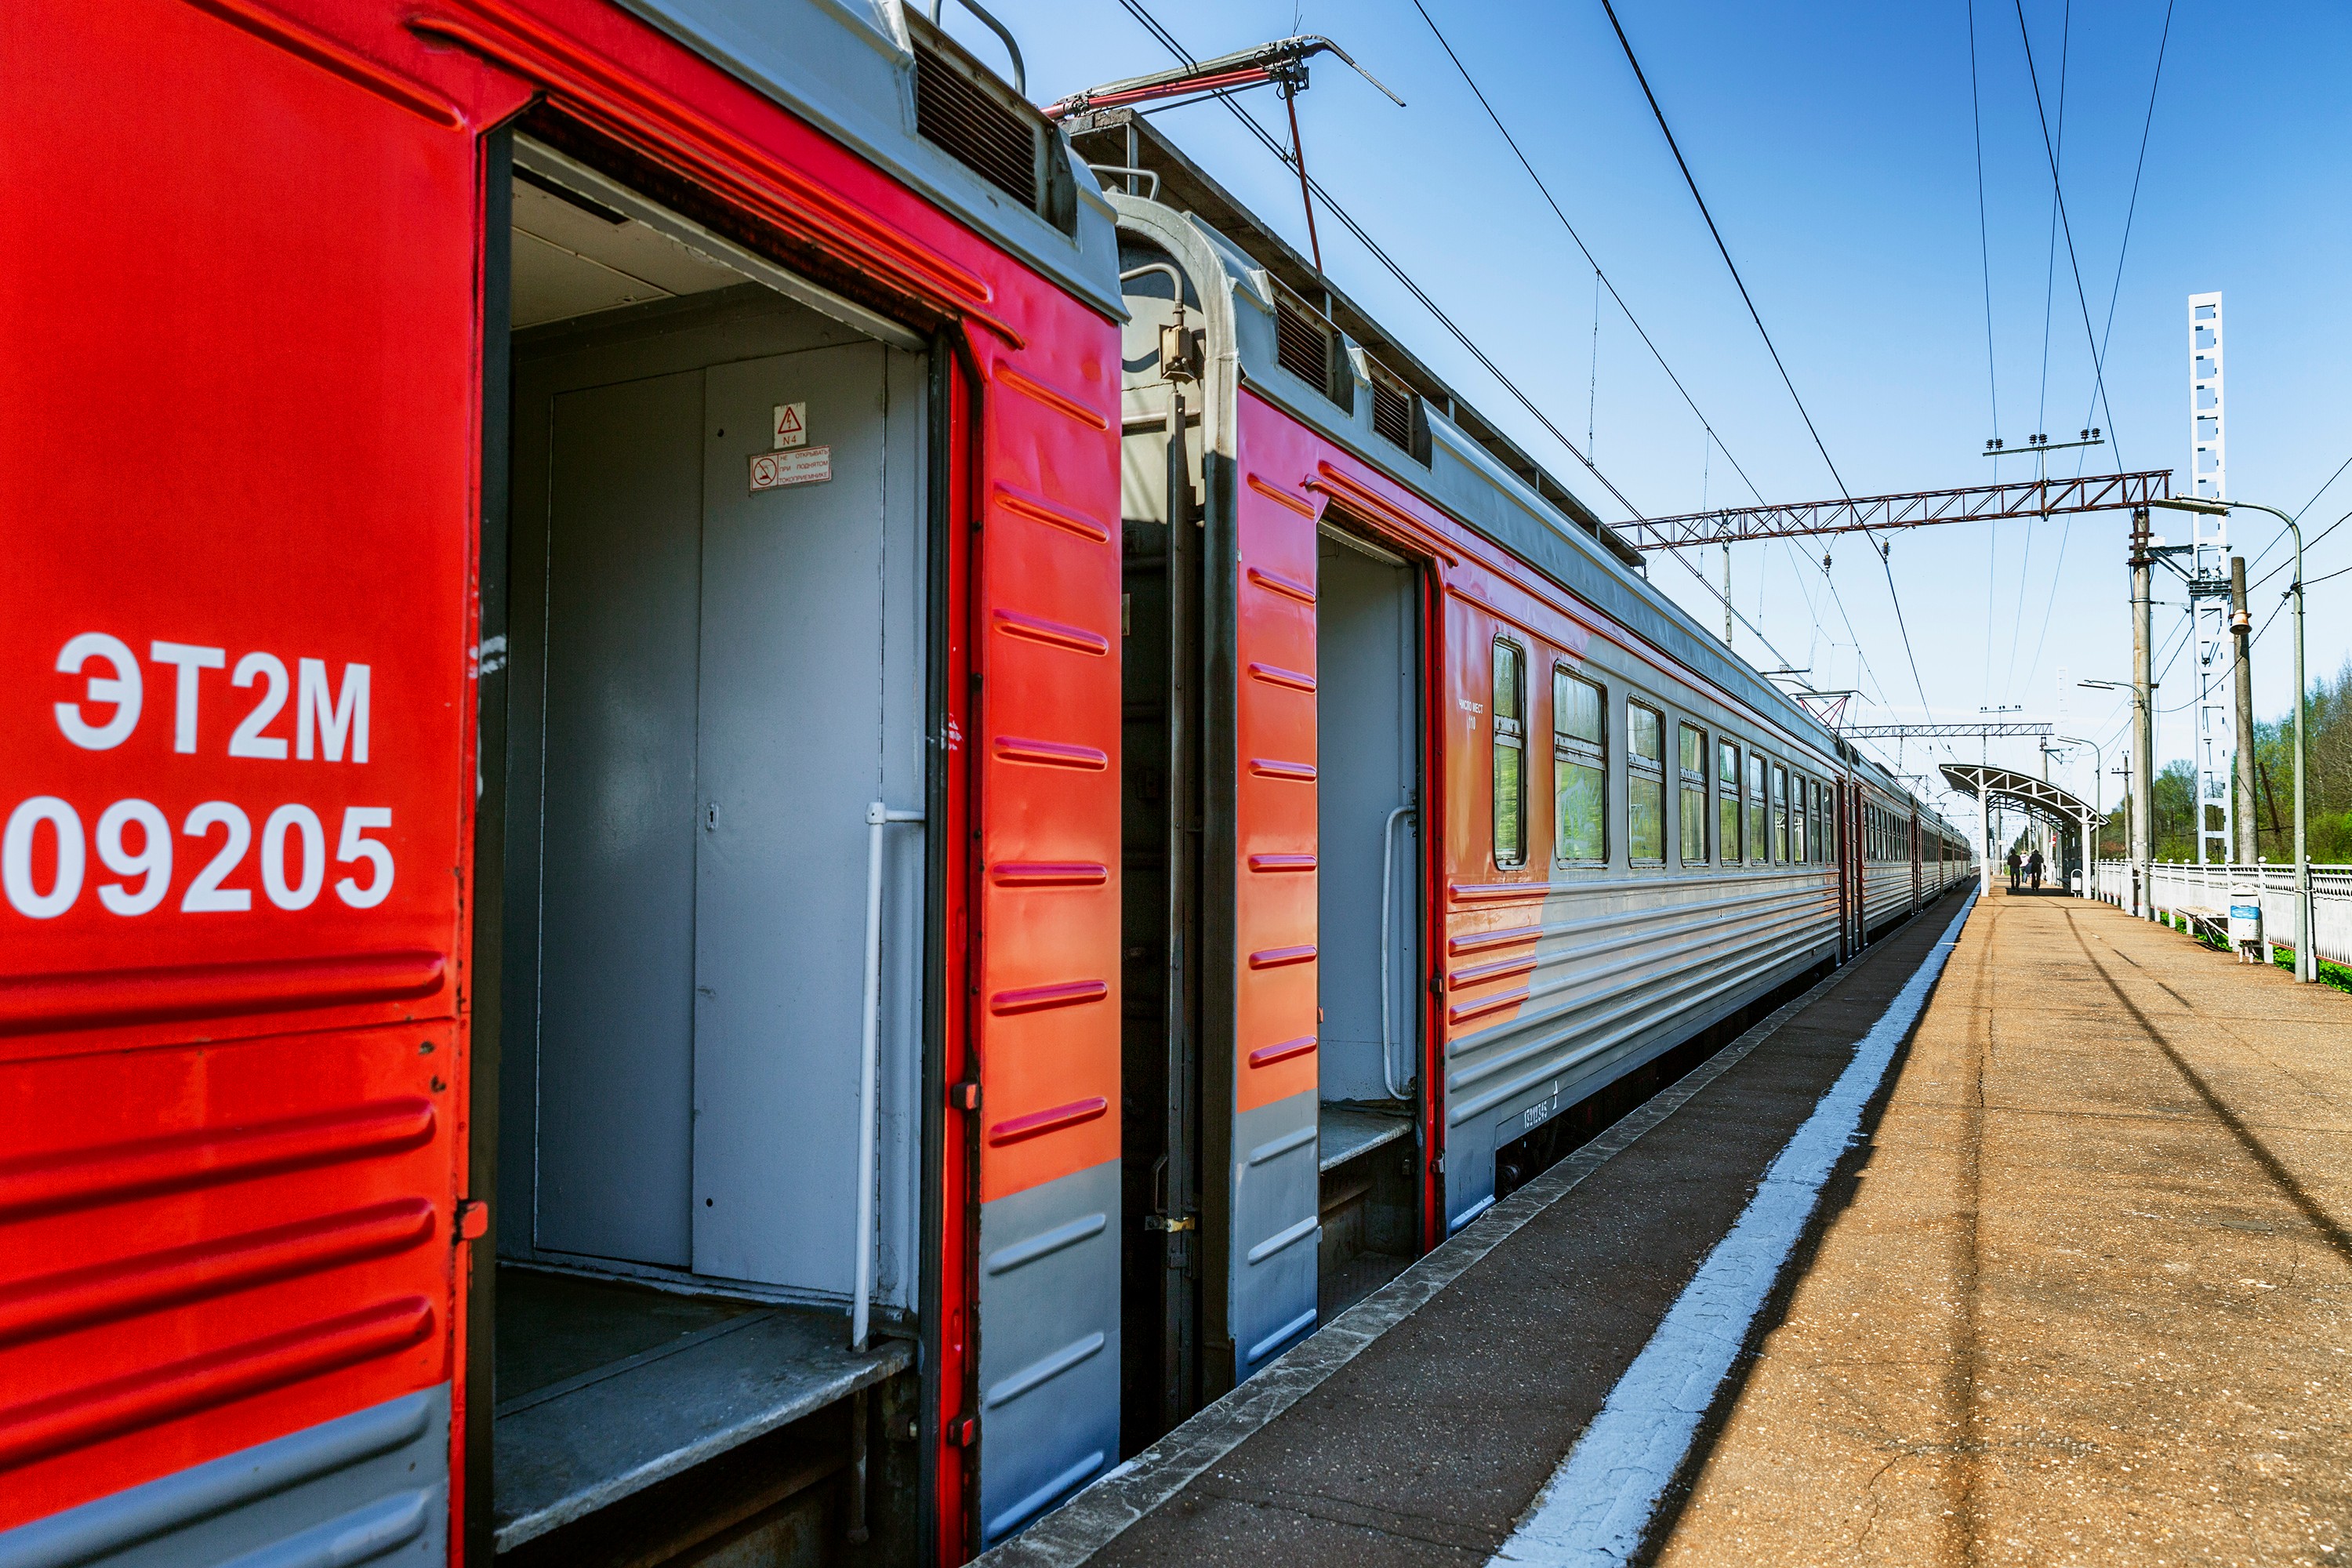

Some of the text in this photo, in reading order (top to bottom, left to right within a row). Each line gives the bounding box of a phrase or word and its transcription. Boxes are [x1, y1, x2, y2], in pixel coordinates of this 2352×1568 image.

[795, 450, 828, 459] ОТКРЫВАТЬ
[797, 461, 828, 470] ПОДНЯТОМ
[779, 472, 827, 483] ТОКОПРИЕМНИКЕ
[54, 632, 371, 764] ЭТ2М
[1472, 702, 1483, 713] МЕСТ
[2, 795, 395, 920] 09205
